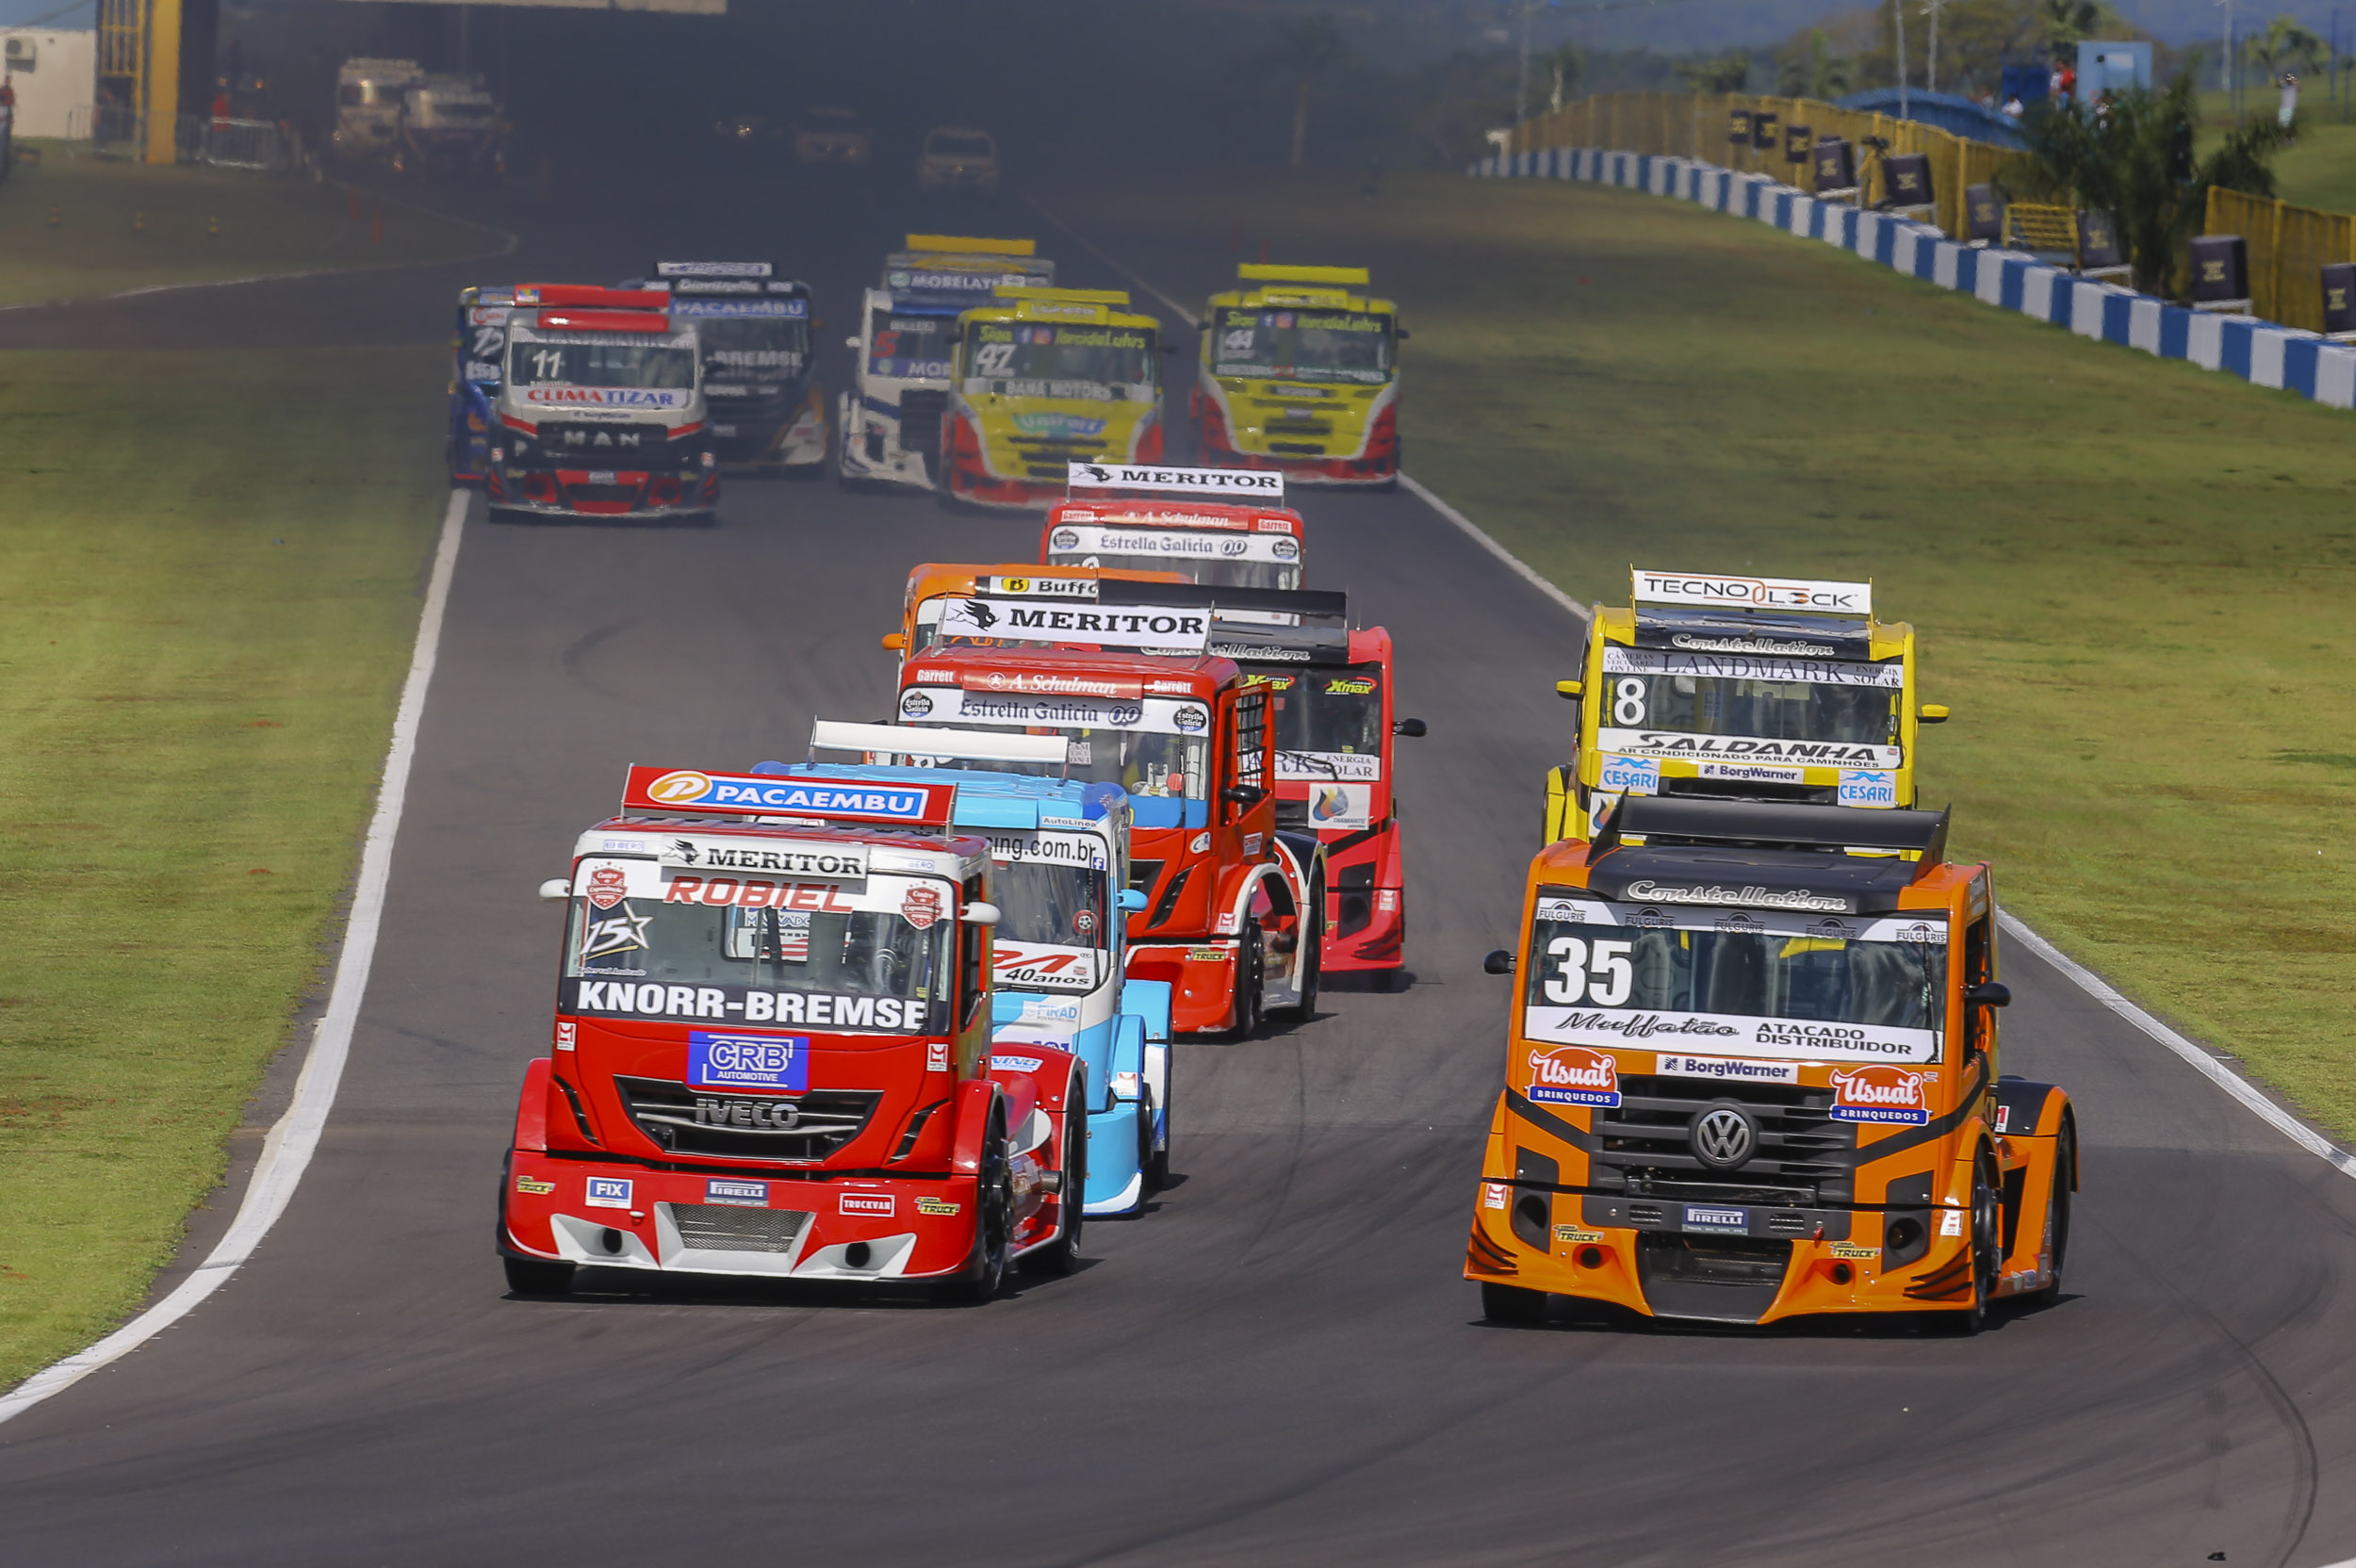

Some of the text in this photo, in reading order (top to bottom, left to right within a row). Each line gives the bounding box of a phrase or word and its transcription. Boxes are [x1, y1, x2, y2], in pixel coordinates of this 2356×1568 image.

[532, 350, 561, 378] 11
[528, 388, 674, 405] CLIMATIZAR
[564, 430, 641, 446] MAN
[1121, 469, 1279, 488] MERITOR
[1101, 536, 1157, 551] Estrella
[1160, 537, 1213, 553] Galicia
[1008, 609, 1203, 635] MERITOR
[1671, 633, 1835, 656] Constellation
[917, 669, 954, 682] Garrett
[1661, 653, 1847, 683] LANDMARK
[1856, 665, 1898, 676] ENERGIA
[1030, 674, 1118, 695] Schulman
[1854, 676, 1899, 687] SOLAR
[958, 698, 1029, 718] Estrella
[1034, 701, 1099, 722] Galicia
[1614, 678, 1646, 726] 8
[1638, 733, 1877, 761] SALDANHA
[1326, 755, 1371, 764] ENERGIA
[1637, 748, 1752, 761] CONDICIONADO
[1796, 756, 1879, 768] CAMINHÕES
[1719, 766, 1799, 781] BorgWarner
[715, 783, 915, 814] PACAEMBU
[1042, 817, 1097, 827] AutoLinea
[707, 847, 861, 874] MERITOR
[663, 875, 853, 913] ROBIEL
[1628, 880, 1847, 910] Constellation
[1538, 909, 1586, 922] FULGURIS
[1625, 916, 1674, 927] FULGURIS
[1714, 921, 1764, 933] FULGURIS
[1806, 926, 1857, 939] FULGURIS
[1896, 931, 1946, 942] FULGURIS
[1544, 936, 1633, 1006] 35
[577, 981, 925, 1030] KNORR-BREMSE
[1758, 1022, 1865, 1039] ATACADO
[1756, 1033, 1911, 1054] DISTRIBUIDOR
[709, 1039, 790, 1073] CRB
[716, 1070, 778, 1082] AUTOMOTIVE
[1531, 1055, 1612, 1087] Usual
[1685, 1058, 1790, 1078] BorgWarner
[1537, 1089, 1611, 1103] BRINQUEDOS
[1833, 1074, 1919, 1104] Usual
[695, 1098, 799, 1128] IVECO
[1841, 1109, 1919, 1121] BRINQUEDOS
[596, 1182, 624, 1197] FIX
[710, 1181, 765, 1198] PIRELLI
[843, 1199, 891, 1211] TRUCKVAN
[1687, 1208, 1743, 1225] PIRELLI
[1561, 1233, 1596, 1241] TRUCK
[1837, 1249, 1874, 1258] TRUCK
